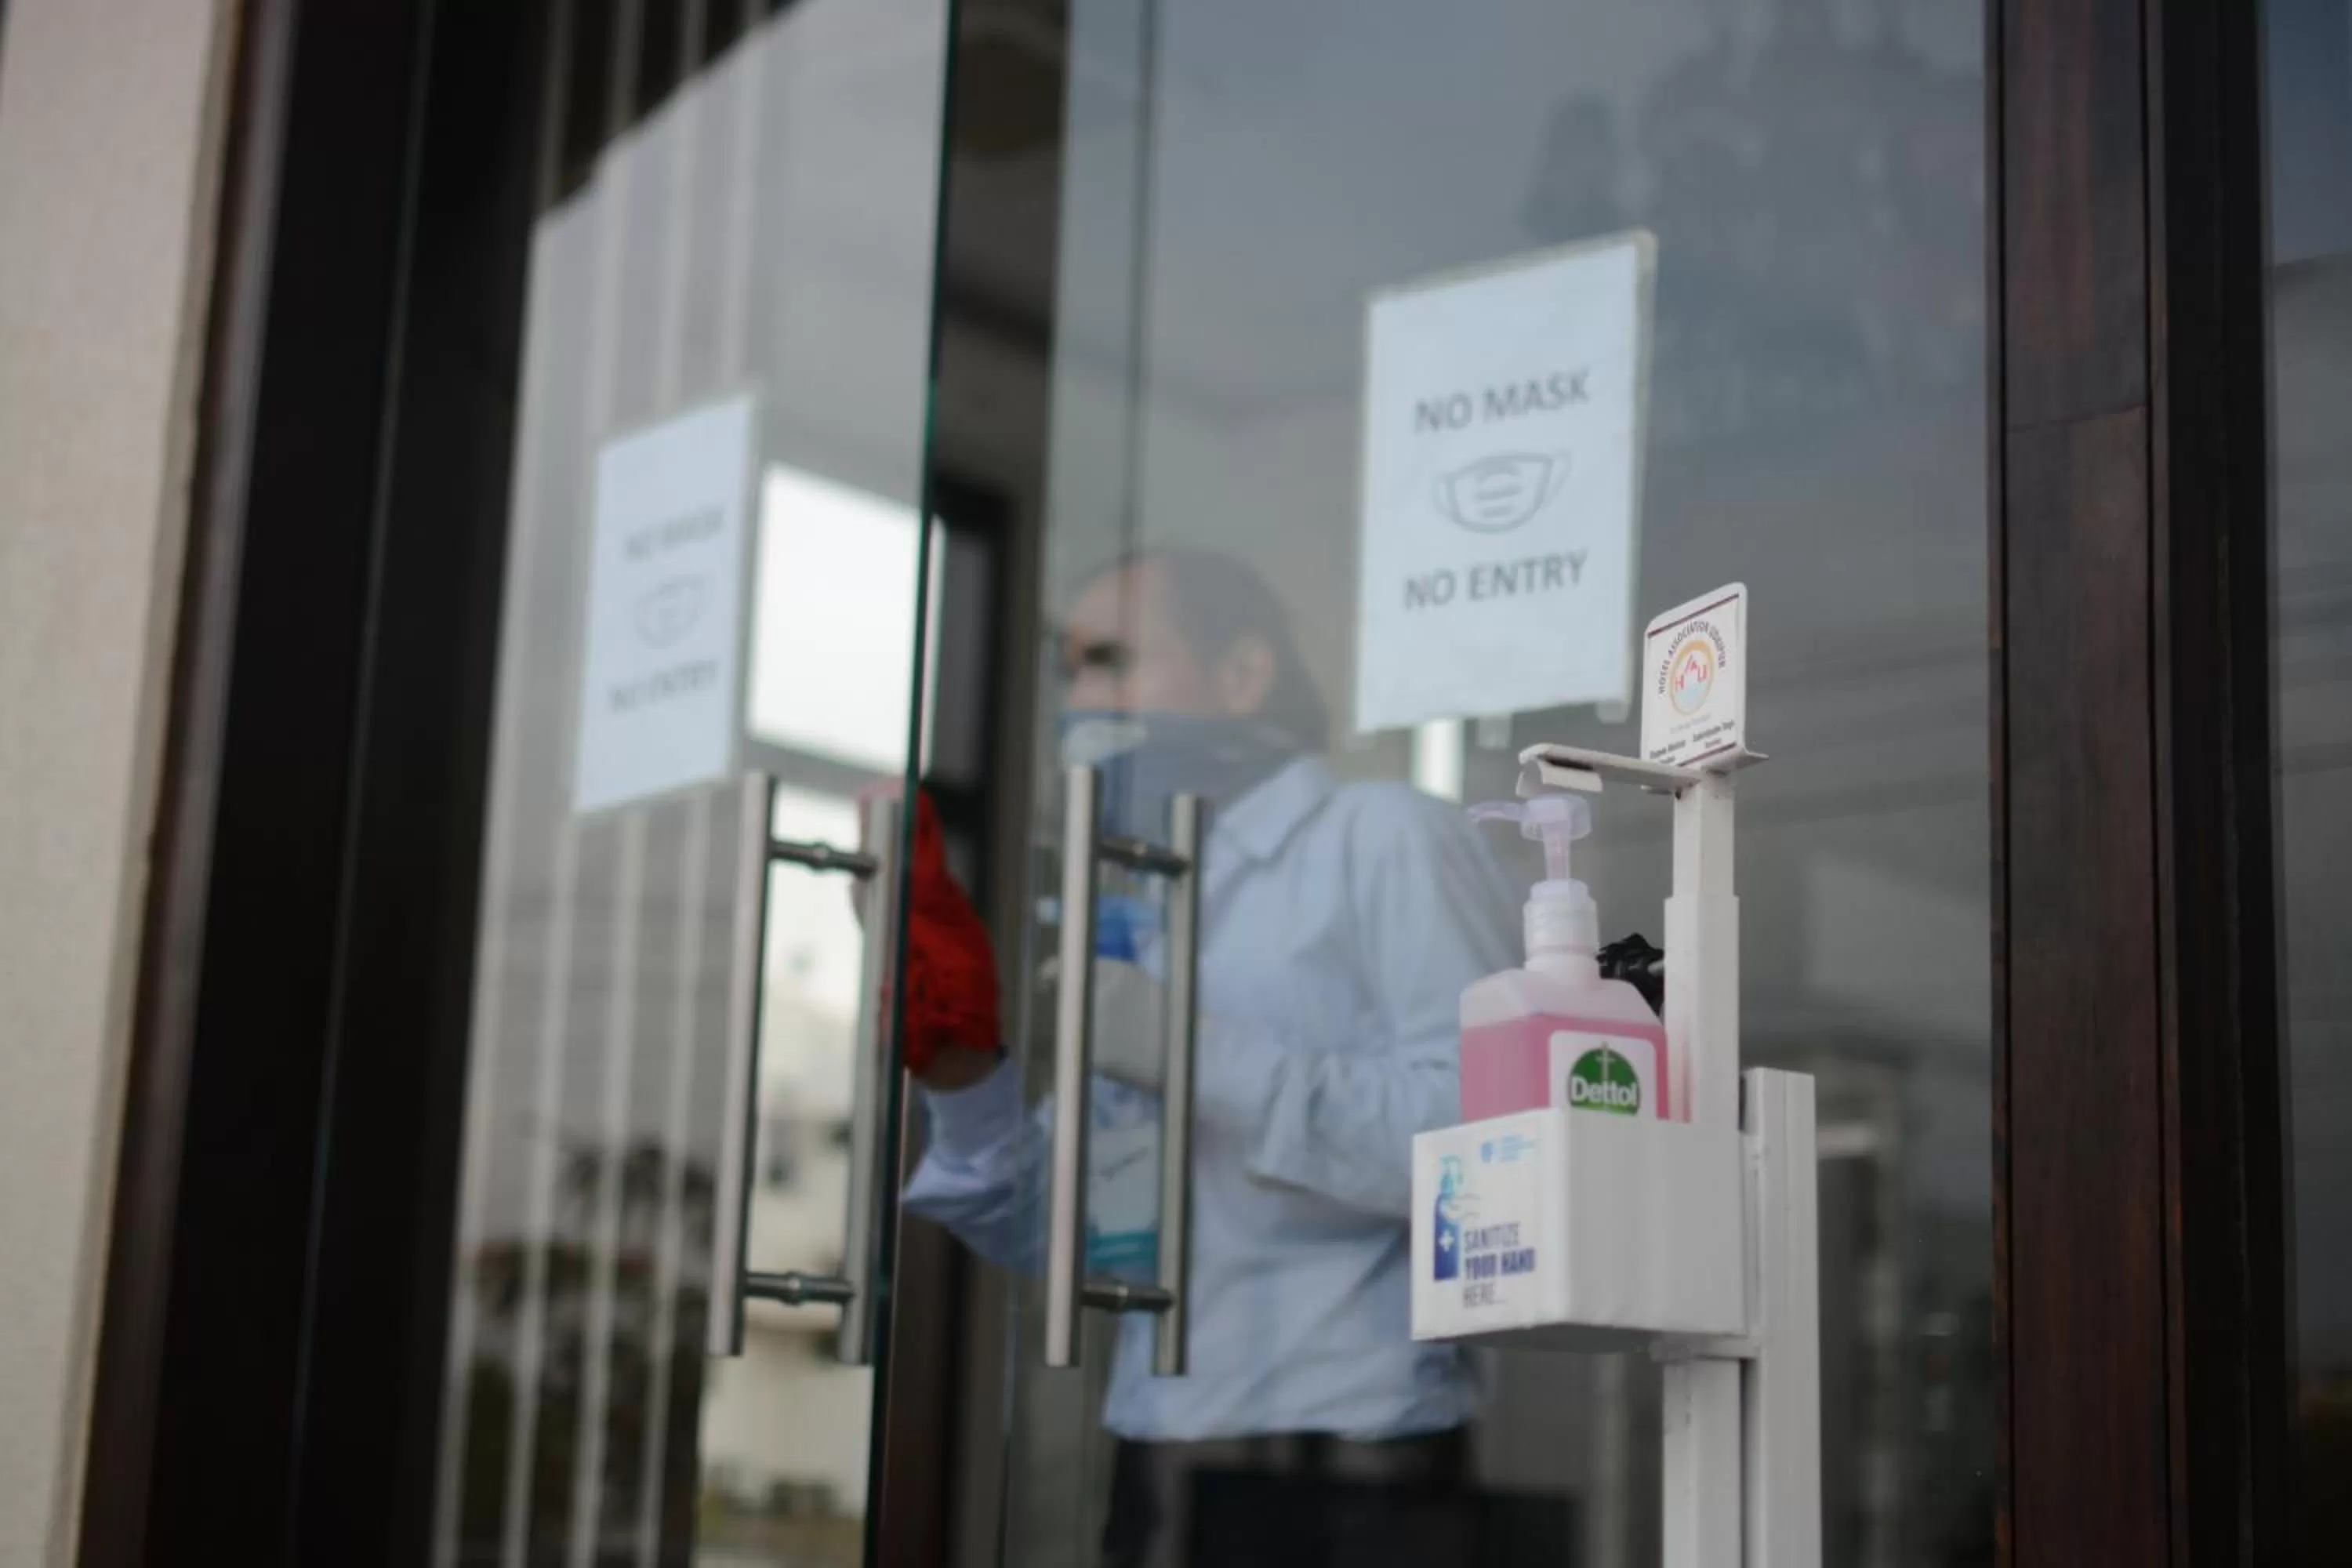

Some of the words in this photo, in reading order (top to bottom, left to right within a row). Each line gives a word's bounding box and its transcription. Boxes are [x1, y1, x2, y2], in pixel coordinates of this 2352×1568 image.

[1414, 393, 1472, 432] NO
[1483, 368, 1591, 419] MASK
[1403, 568, 1457, 611] NO
[1468, 550, 1588, 601] ENTRY
[1658, 659, 1670, 695] HOTEL
[1571, 1076, 1638, 1106] Dettol
[1465, 1254, 1497, 1280] YOUR
[1501, 1247, 1536, 1275] HAND
